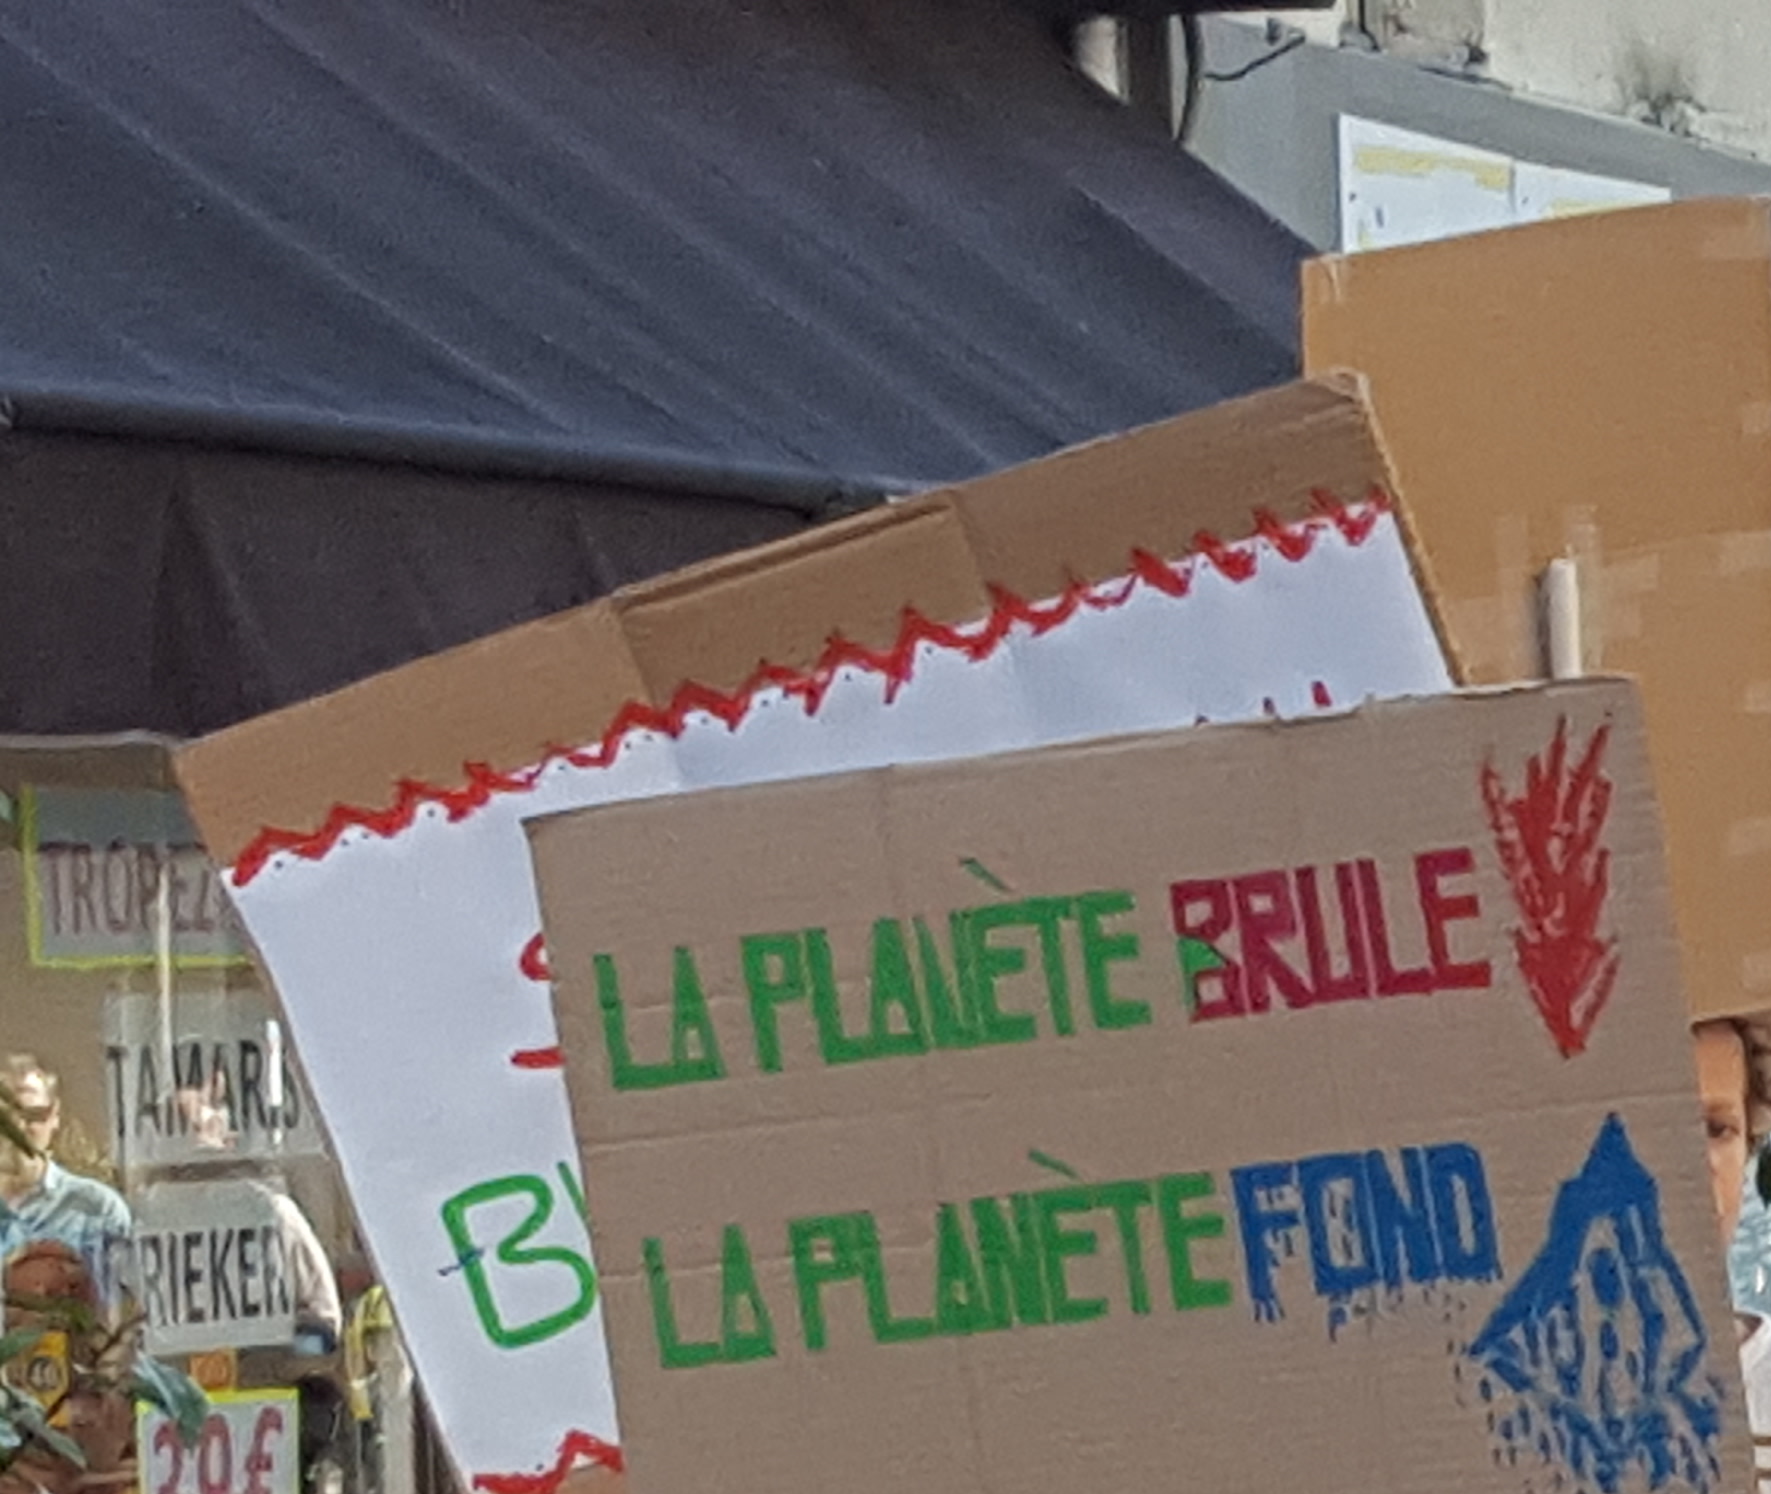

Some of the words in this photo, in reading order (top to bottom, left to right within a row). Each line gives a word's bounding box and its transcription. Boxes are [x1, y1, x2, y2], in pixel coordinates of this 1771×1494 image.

[592, 943, 728, 1091] LA
[739, 856, 1153, 1073] PLANÈTE
[1169, 846, 1494, 1025] BRULE
[643, 1222, 778, 1370] LA
[788, 1148, 1232, 1352] PLANÈTE
[1230, 1142, 1502, 1325] FOND
